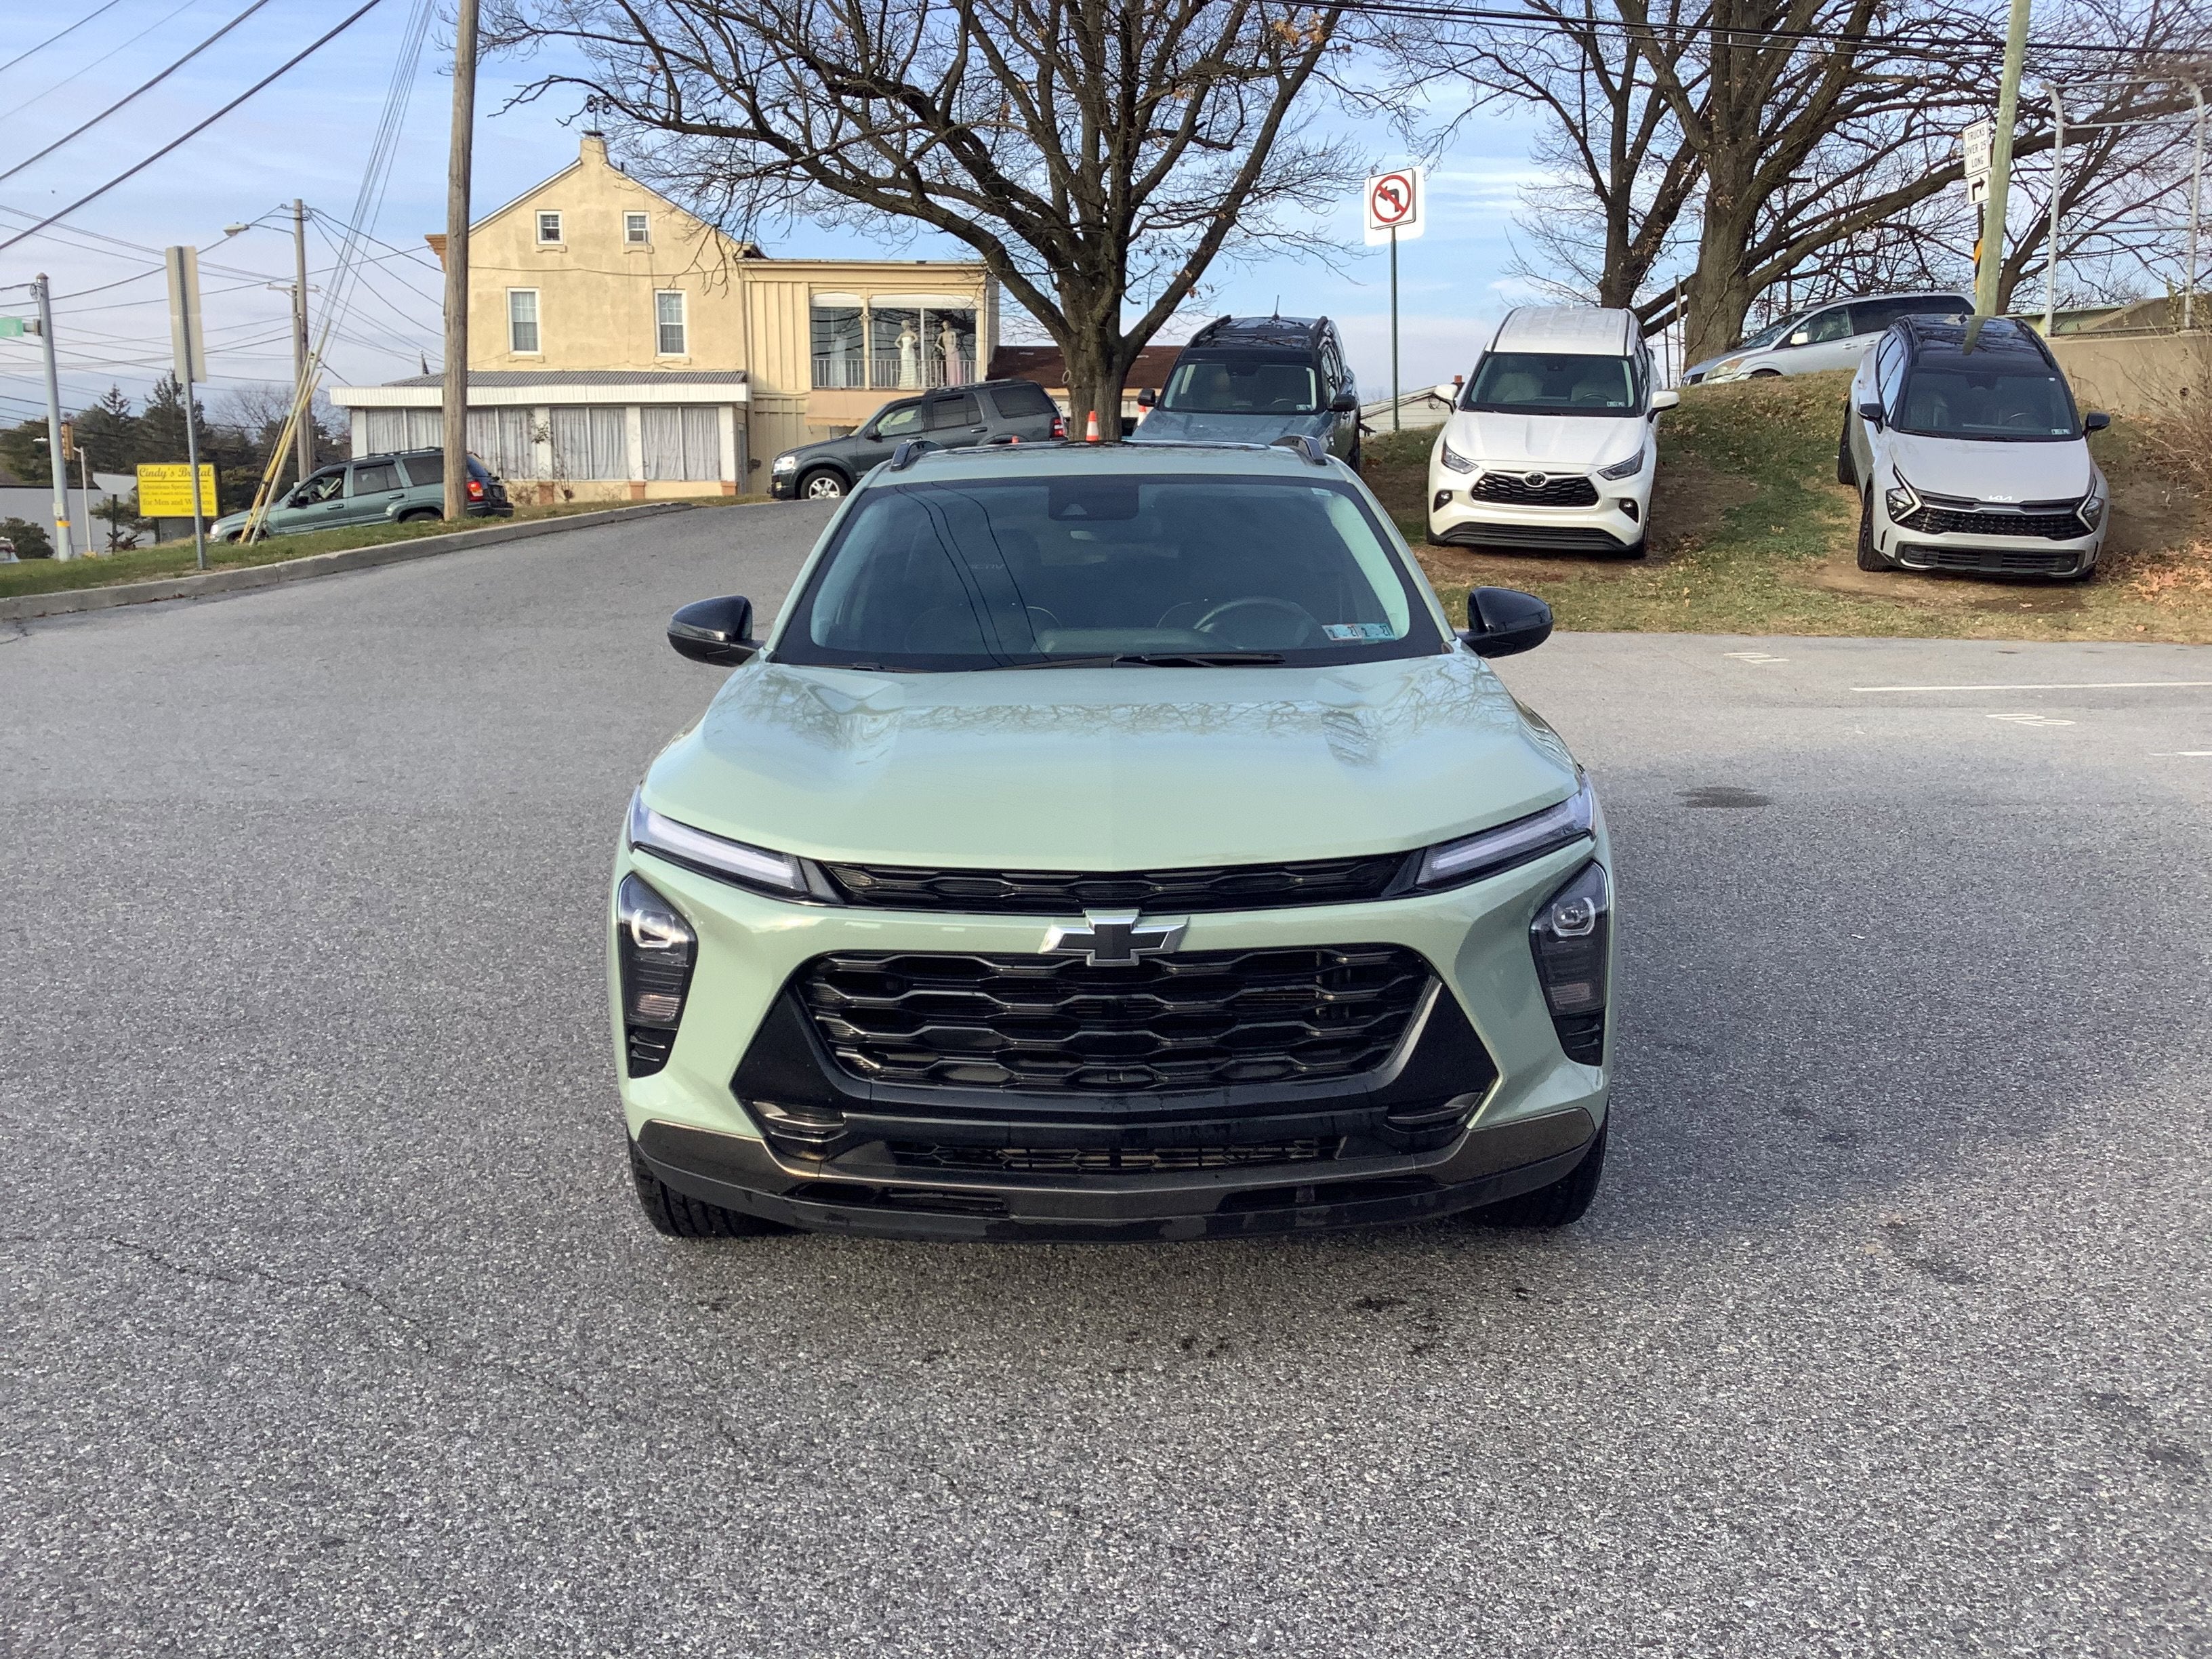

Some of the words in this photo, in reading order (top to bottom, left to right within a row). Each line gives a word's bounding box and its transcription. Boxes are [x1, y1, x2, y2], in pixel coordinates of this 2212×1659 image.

[1967, 127, 1985, 142] TRUCKS
[1966, 143, 1978, 156] OVER
[1971, 155, 1984, 167] LONG
[139, 467, 174, 480] Cindy's
[178, 467, 211, 477] Bral
